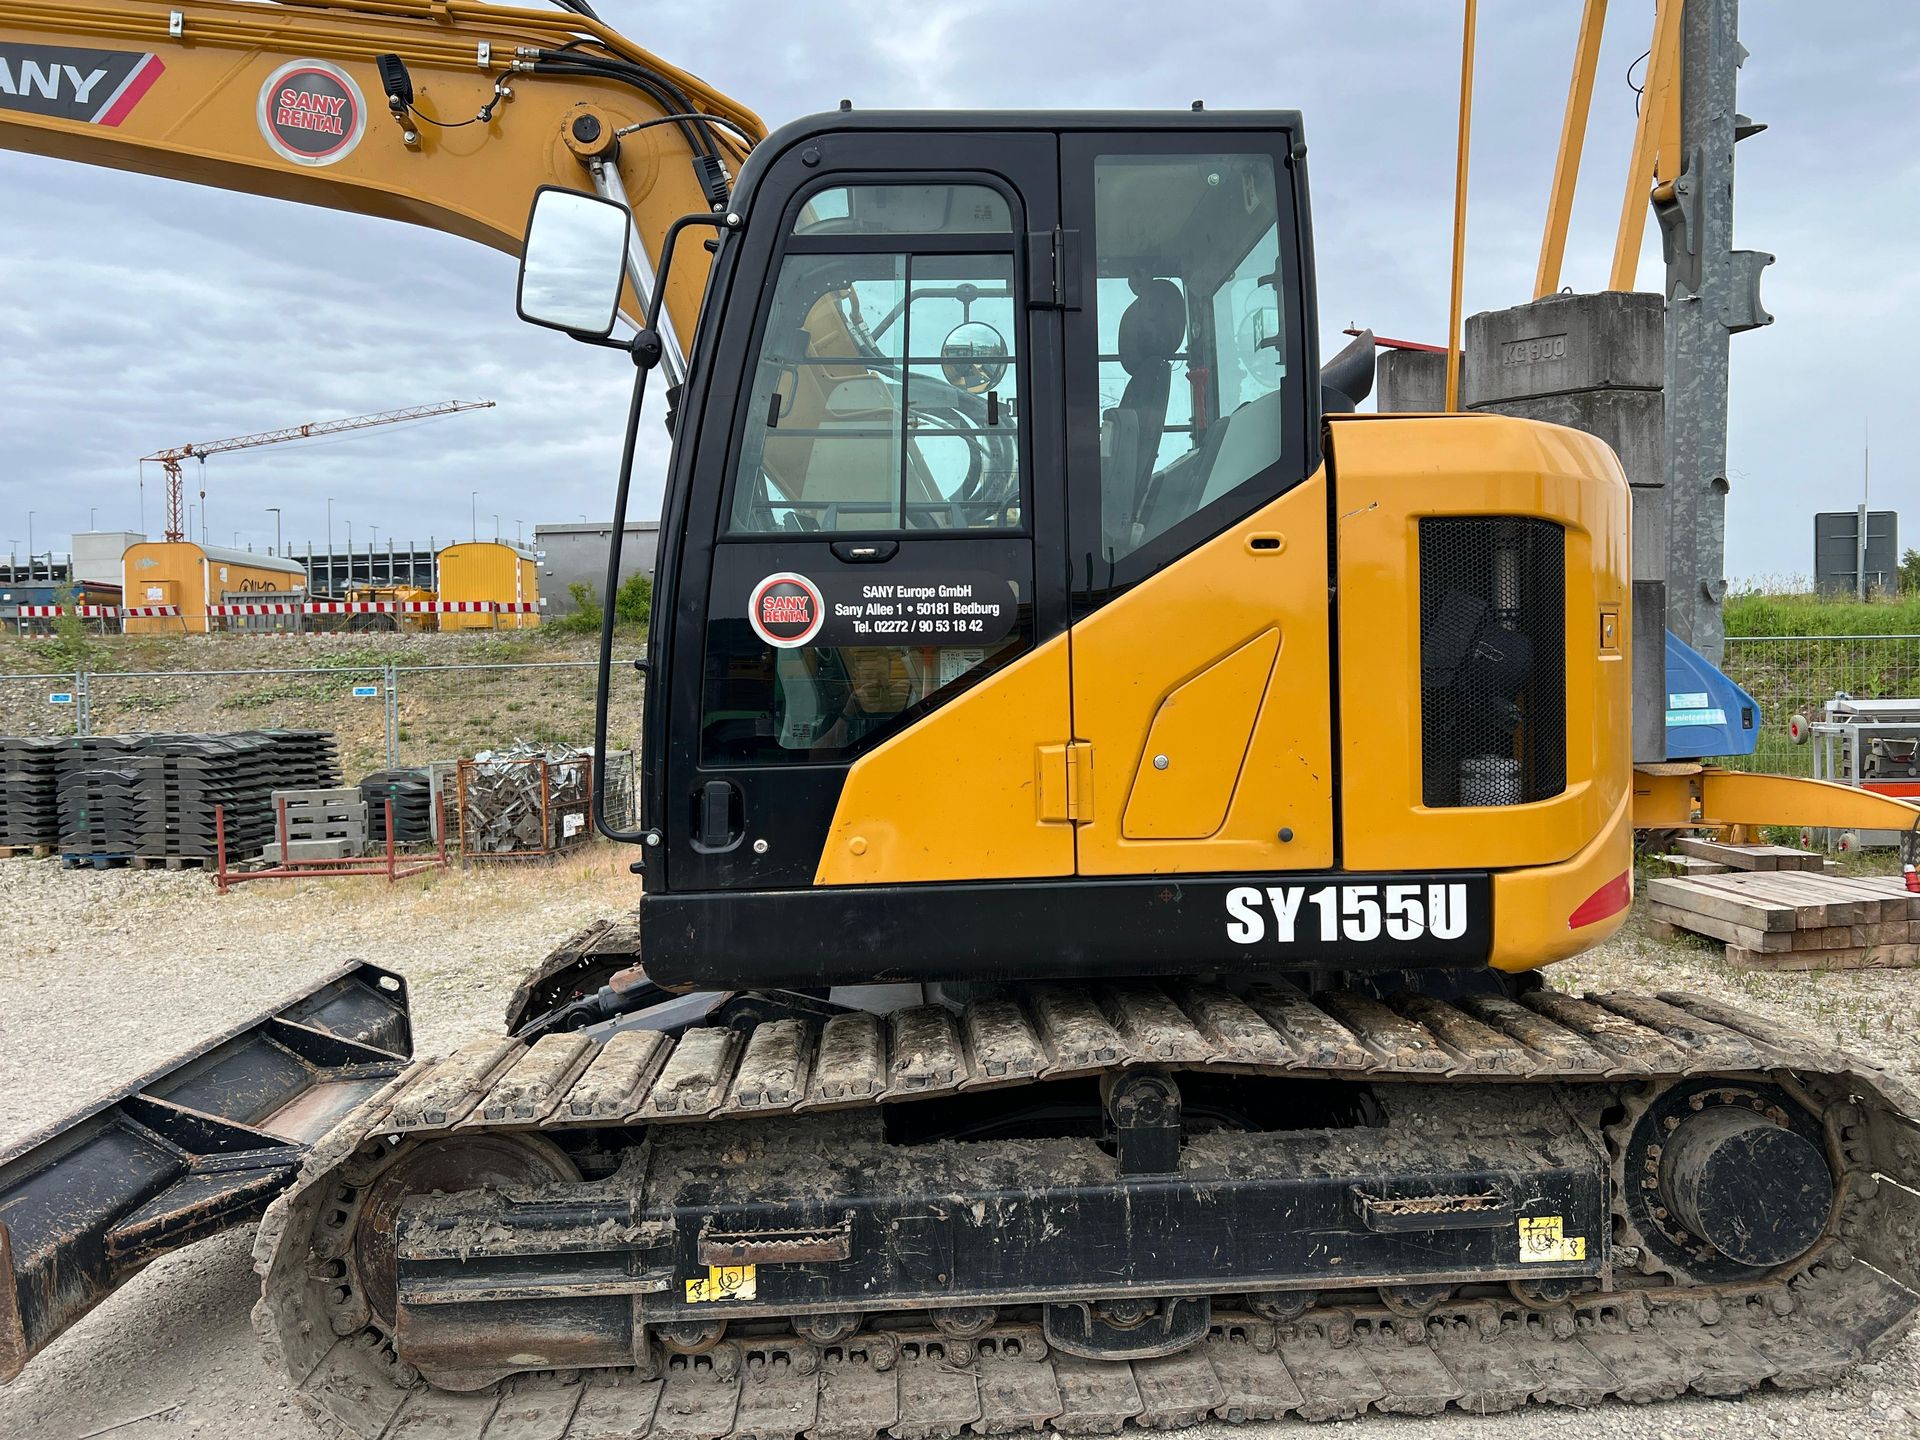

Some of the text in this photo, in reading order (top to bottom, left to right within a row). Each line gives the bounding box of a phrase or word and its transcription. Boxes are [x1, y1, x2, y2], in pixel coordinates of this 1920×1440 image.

[280, 88, 346, 116] SANY
[277, 107, 343, 135] RENTAL
[1529, 336, 1566, 361] 900
[863, 585, 972, 600] SANY Europe GmbH
[763, 596, 809, 610] SANY
[835, 603, 863, 618] Sany
[866, 603, 894, 615] Allee
[896, 603, 902, 615] 1
[916, 602, 950, 615] 50181
[953, 602, 1000, 617] Bedburg
[763, 609, 810, 623] RENTAL
[853, 620, 872, 633] Tel.
[874, 620, 908, 633] 02272
[918, 620, 933, 632] 90
[935, 620, 950, 632] 53
[954, 620, 967, 632] 18
[969, 619, 983, 632] 42
[1225, 883, 1468, 944] SY155U
